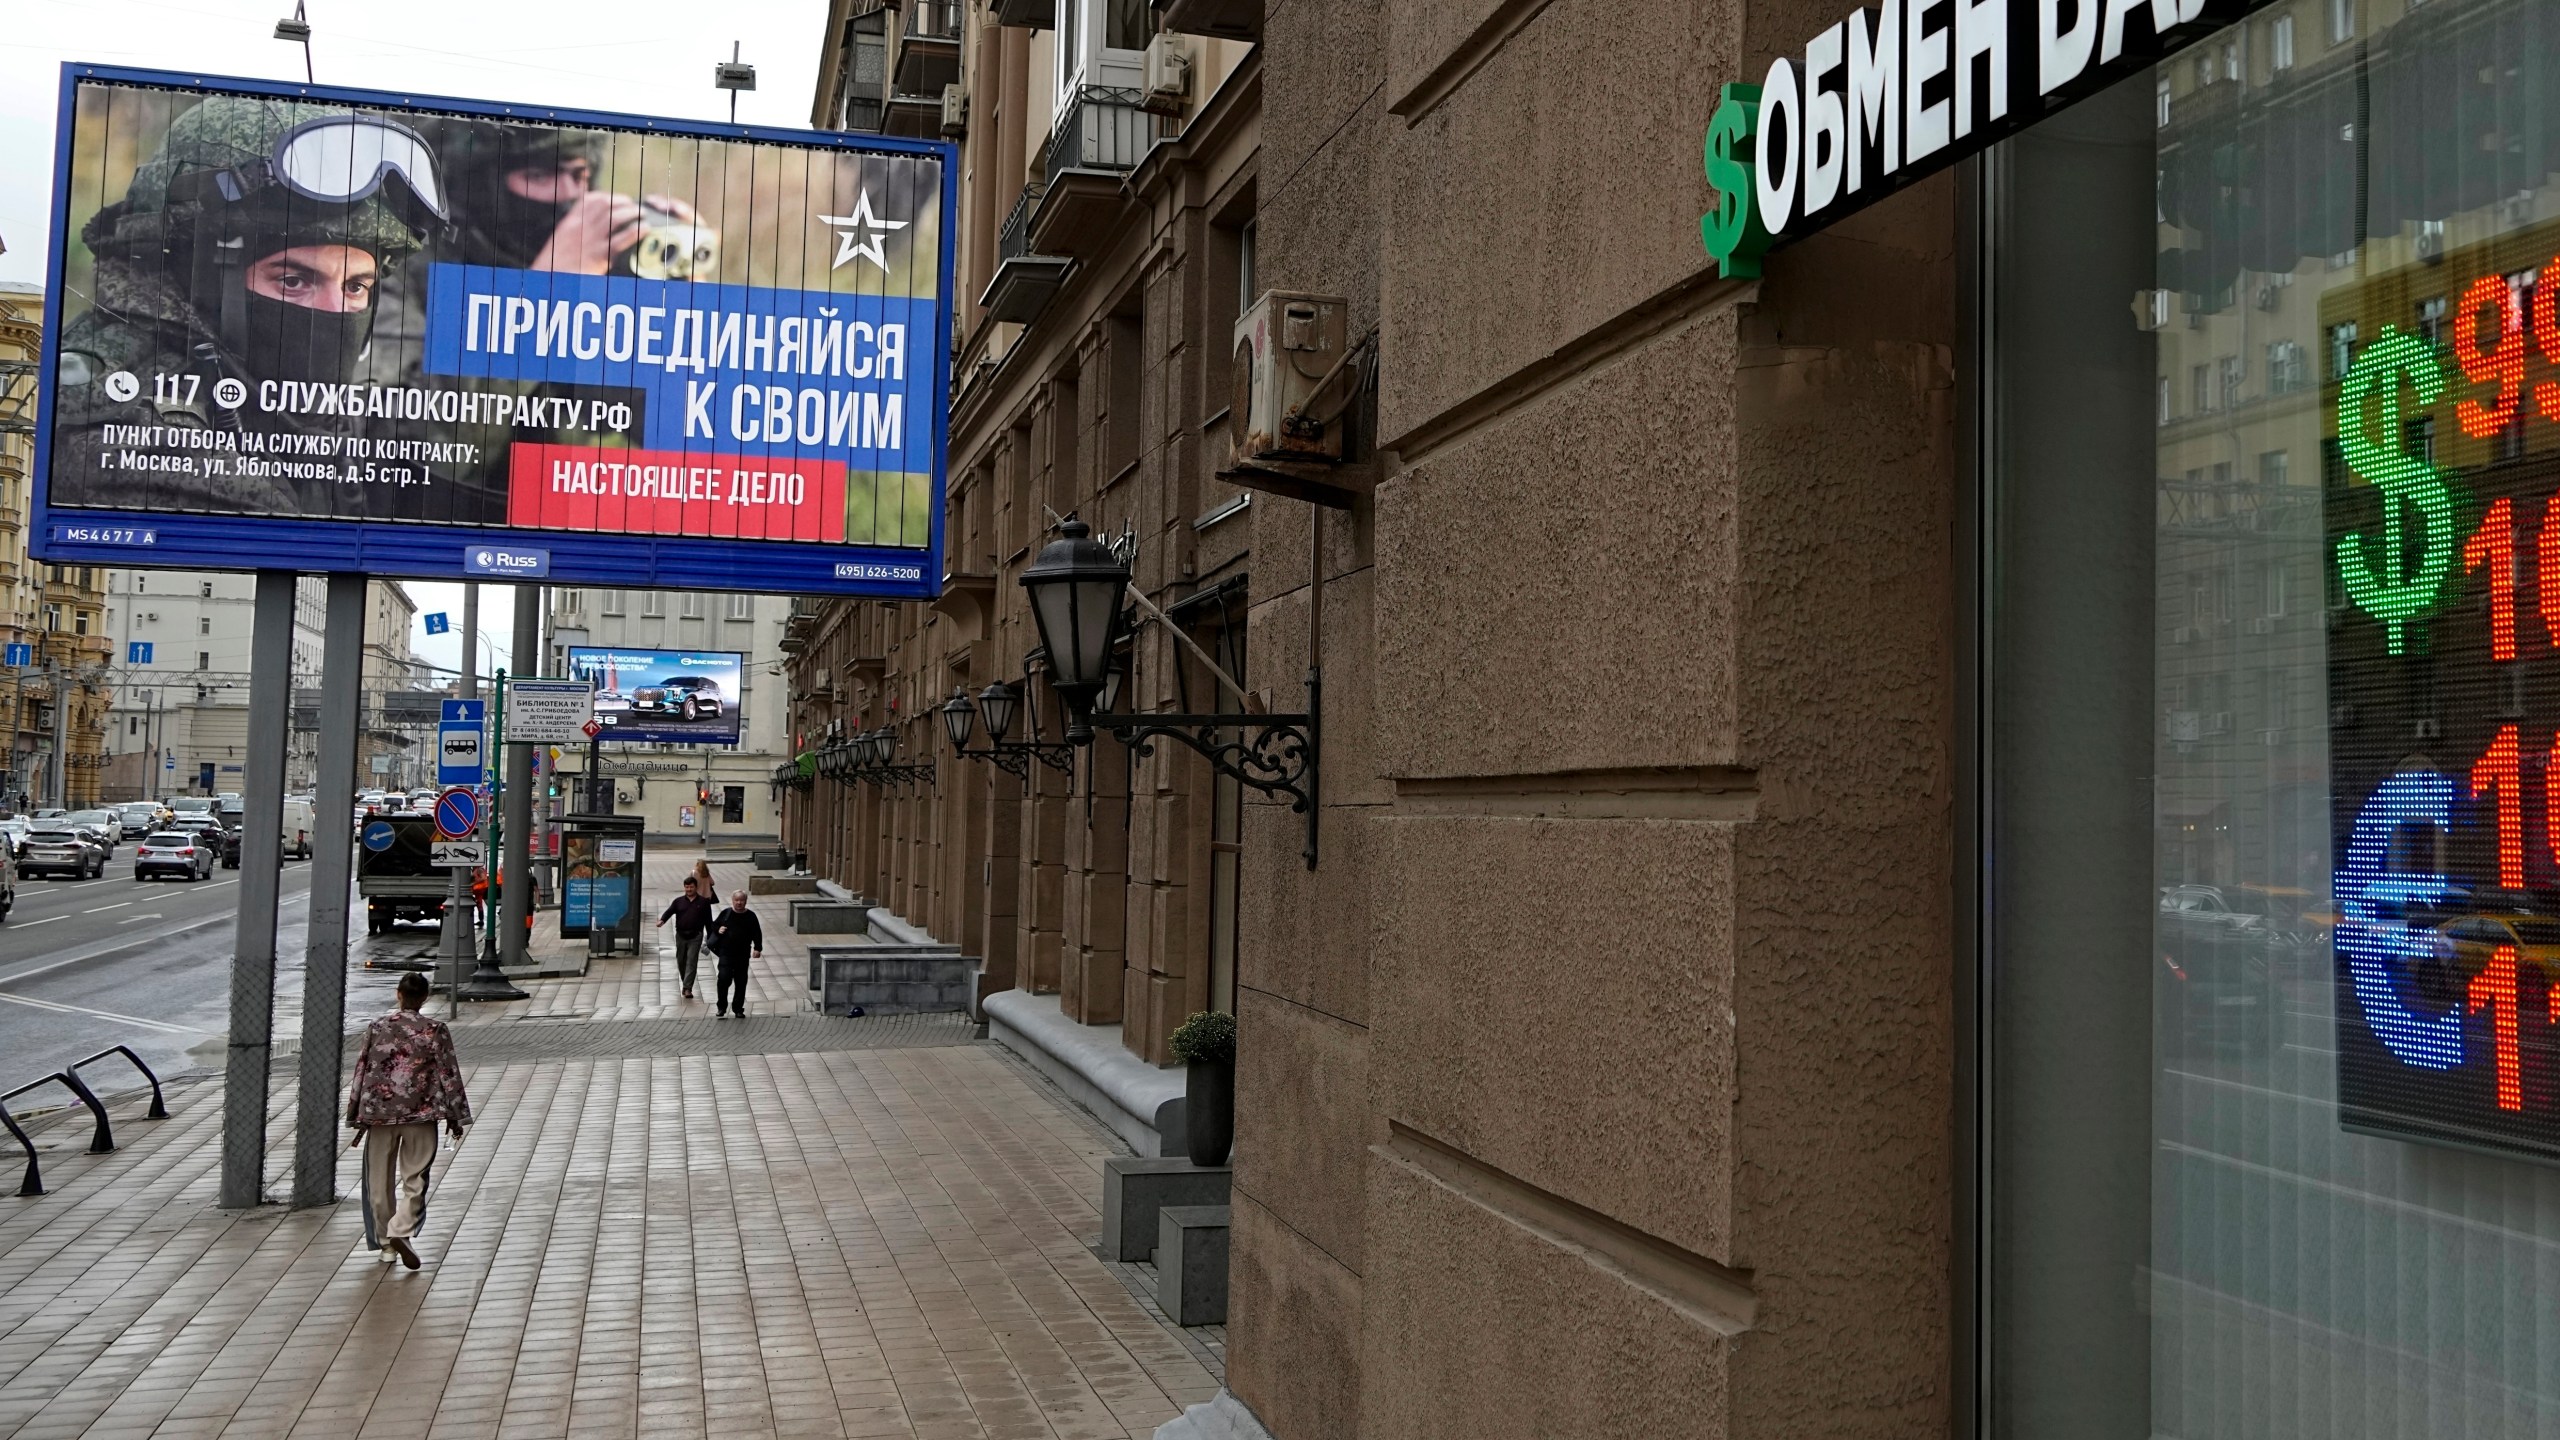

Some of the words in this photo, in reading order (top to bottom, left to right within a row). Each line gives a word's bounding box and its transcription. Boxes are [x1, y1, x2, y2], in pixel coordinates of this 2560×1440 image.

[1755, 0, 2008, 235] ОБМЕН
[466, 293, 906, 380] ПРИСОЕДИНЯЙСЯ
[154, 372, 201, 406] 117
[260, 379, 633, 433] СЛУЖБАПОКОНТРАКТУ.РФ
[683, 380, 719, 440] К
[730, 383, 903, 450] СВОИМ
[102, 423, 164, 447] ПУНКТ
[167, 427, 237, 451] ОТБОРА
[241, 432, 265, 453] НА
[269, 433, 343, 457] СЛУЖБУ
[347, 438, 370, 459] ПО
[375, 439, 480, 464] КОНТРАКТУ:
[100, 452, 114, 469] г.
[120, 449, 199, 476] Москва,
[203, 457, 231, 478] ул.
[236, 455, 342, 483] Яблочкова,
[346, 462, 376, 483] д.5
[380, 465, 417, 488] стр.
[422, 465, 431, 485] 1
[552, 459, 722, 502] НАСТОЯЩЕЕ
[728, 468, 805, 507] ДЕЛО
[143, 532, 154, 544] A
[496, 552, 538, 568] Russ
[835, 564, 864, 578] (495)
[867, 566, 920, 579] 626-5200
[2465, 498, 2560, 660] 1
[579, 654, 607, 663] НОВОЕ
[608, 654, 654, 664] ПОКОЛЕНИЕ
[2470, 725, 2560, 888] 1
[2469, 945, 2560, 1111] 1
